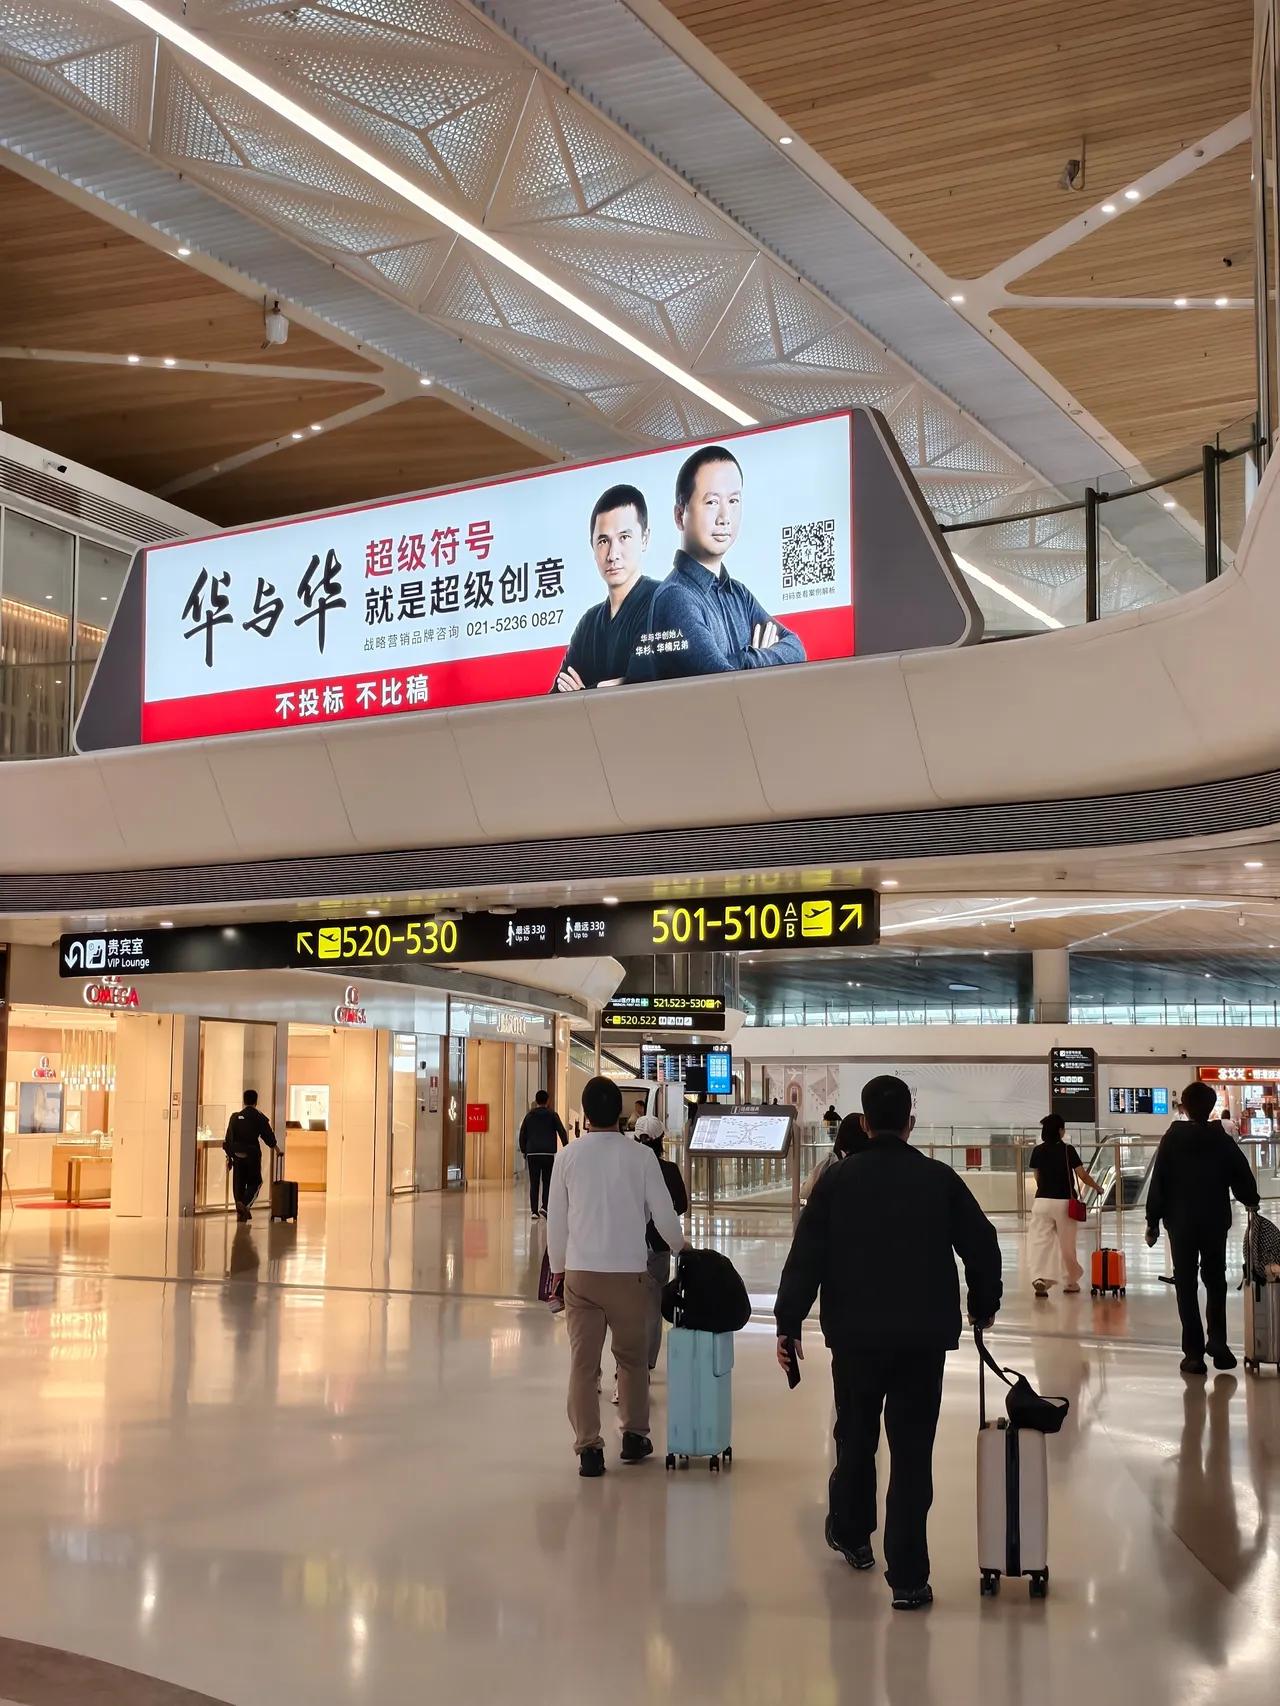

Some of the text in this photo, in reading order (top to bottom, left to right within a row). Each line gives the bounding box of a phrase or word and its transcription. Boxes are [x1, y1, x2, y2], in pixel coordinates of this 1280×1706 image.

[365, 520, 494, 579] 超级符号
[181, 548, 347, 668] 华与华
[365, 557, 565, 626] 就是超级创意
[364, 609, 564, 652] 战略营销品牌咨询 021-5236 0827
[640, 628, 684, 643] 华与华创始人
[275, 673, 429, 720] 不投标 不比稿
[652, 903, 781, 943] 501-510
[785, 902, 797, 917] A
[107, 938, 144, 955] 贵宾室
[343, 920, 458, 957] 520-530
[786, 922, 795, 938] B
[107, 957, 150, 970] VIP Lounge
[84, 983, 141, 1006] OMEGA
